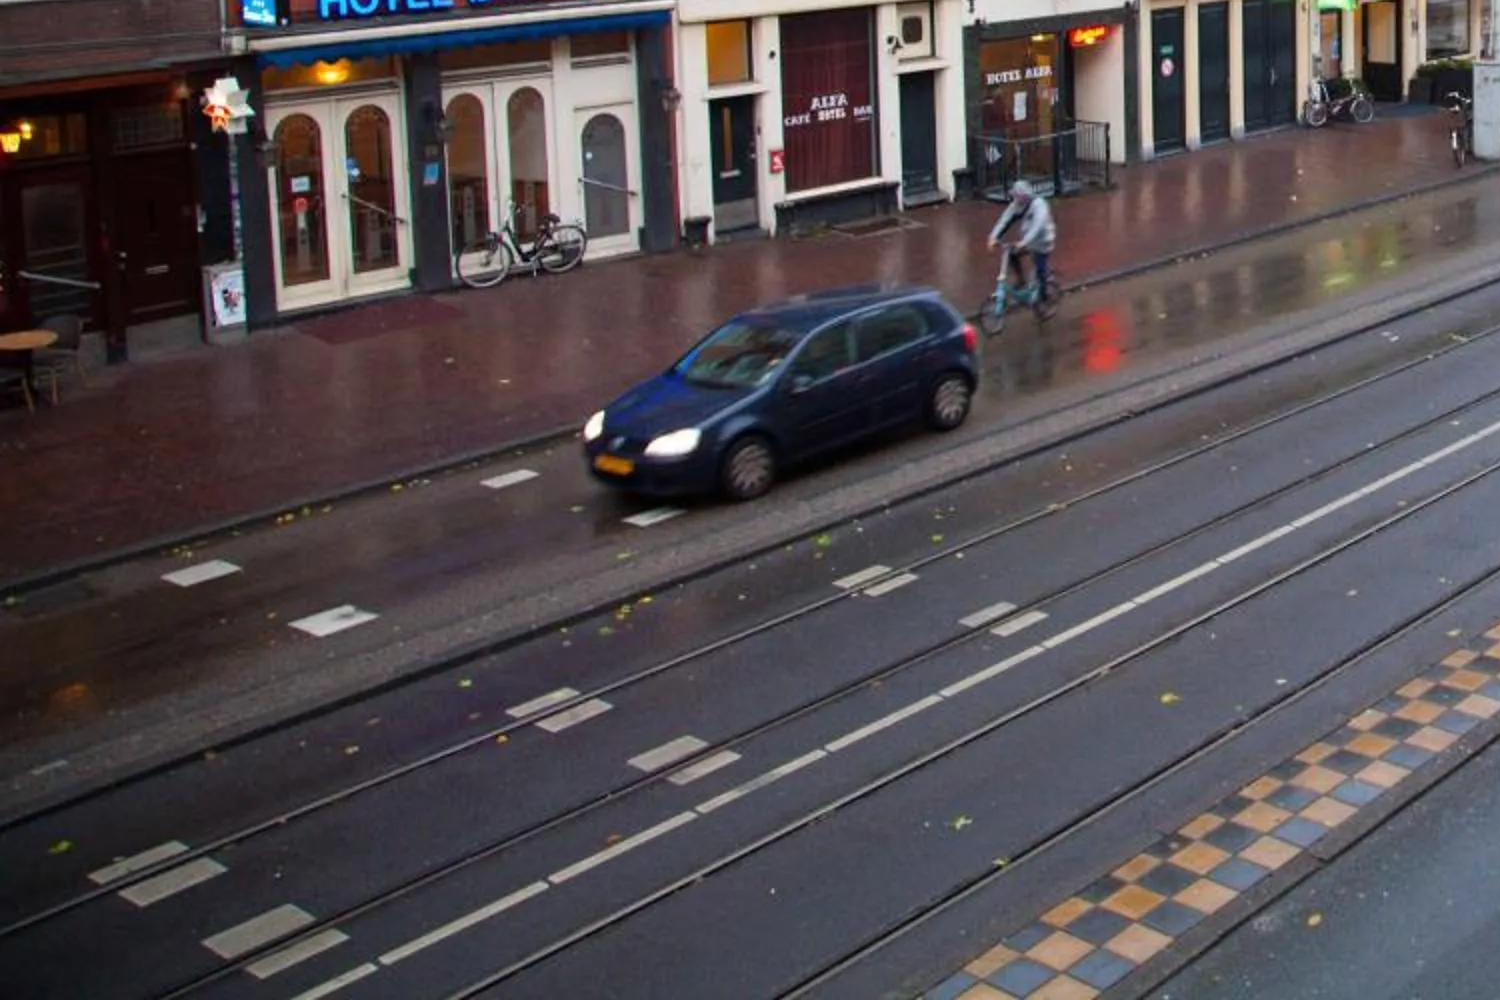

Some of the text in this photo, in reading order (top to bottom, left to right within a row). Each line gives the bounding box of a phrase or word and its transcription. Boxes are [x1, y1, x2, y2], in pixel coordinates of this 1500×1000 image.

[985, 69, 1021, 85] HOTEL
[810, 93, 848, 111] ALFA
[853, 105, 873, 117] BAR
